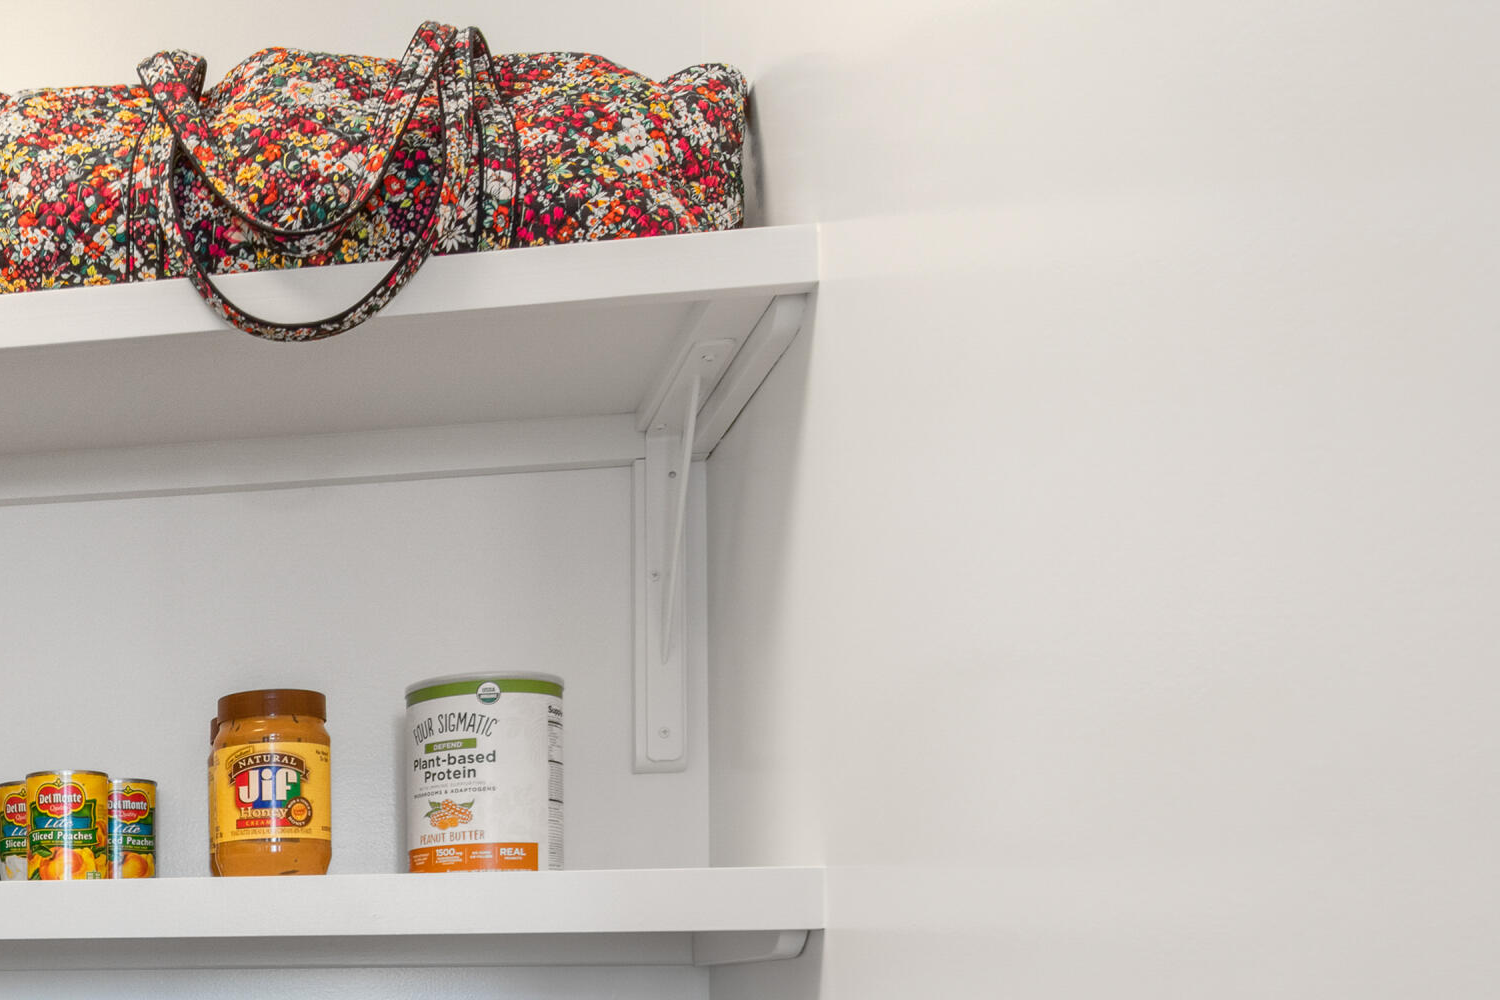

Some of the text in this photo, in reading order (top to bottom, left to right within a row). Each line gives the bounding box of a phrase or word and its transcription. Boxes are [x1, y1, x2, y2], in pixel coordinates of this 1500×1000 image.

[413, 711, 498, 746] FOUR SIGMATIC
[433, 741, 463, 751] DEFEND
[238, 754, 298, 768] NATURAL
[414, 750, 497, 772] Plant-based
[424, 767, 477, 783] Protein
[238, 768, 298, 804] Jif
[450, 786, 496, 794] ADAPTOGENS
[40, 793, 82, 804] Del Monte
[6, 804, 17, 814] Del
[122, 800, 148, 810] Monte
[240, 806, 288, 818] Honey
[44, 818, 74, 828] Lite
[32, 830, 93, 842] Sliced Peaches
[420, 830, 486, 846] PEANUT BUTTER
[6, 838, 26, 848] Sliced
[126, 837, 154, 846] Peaches
[436, 848, 456, 857] 1500
[500, 848, 526, 856] REAL
